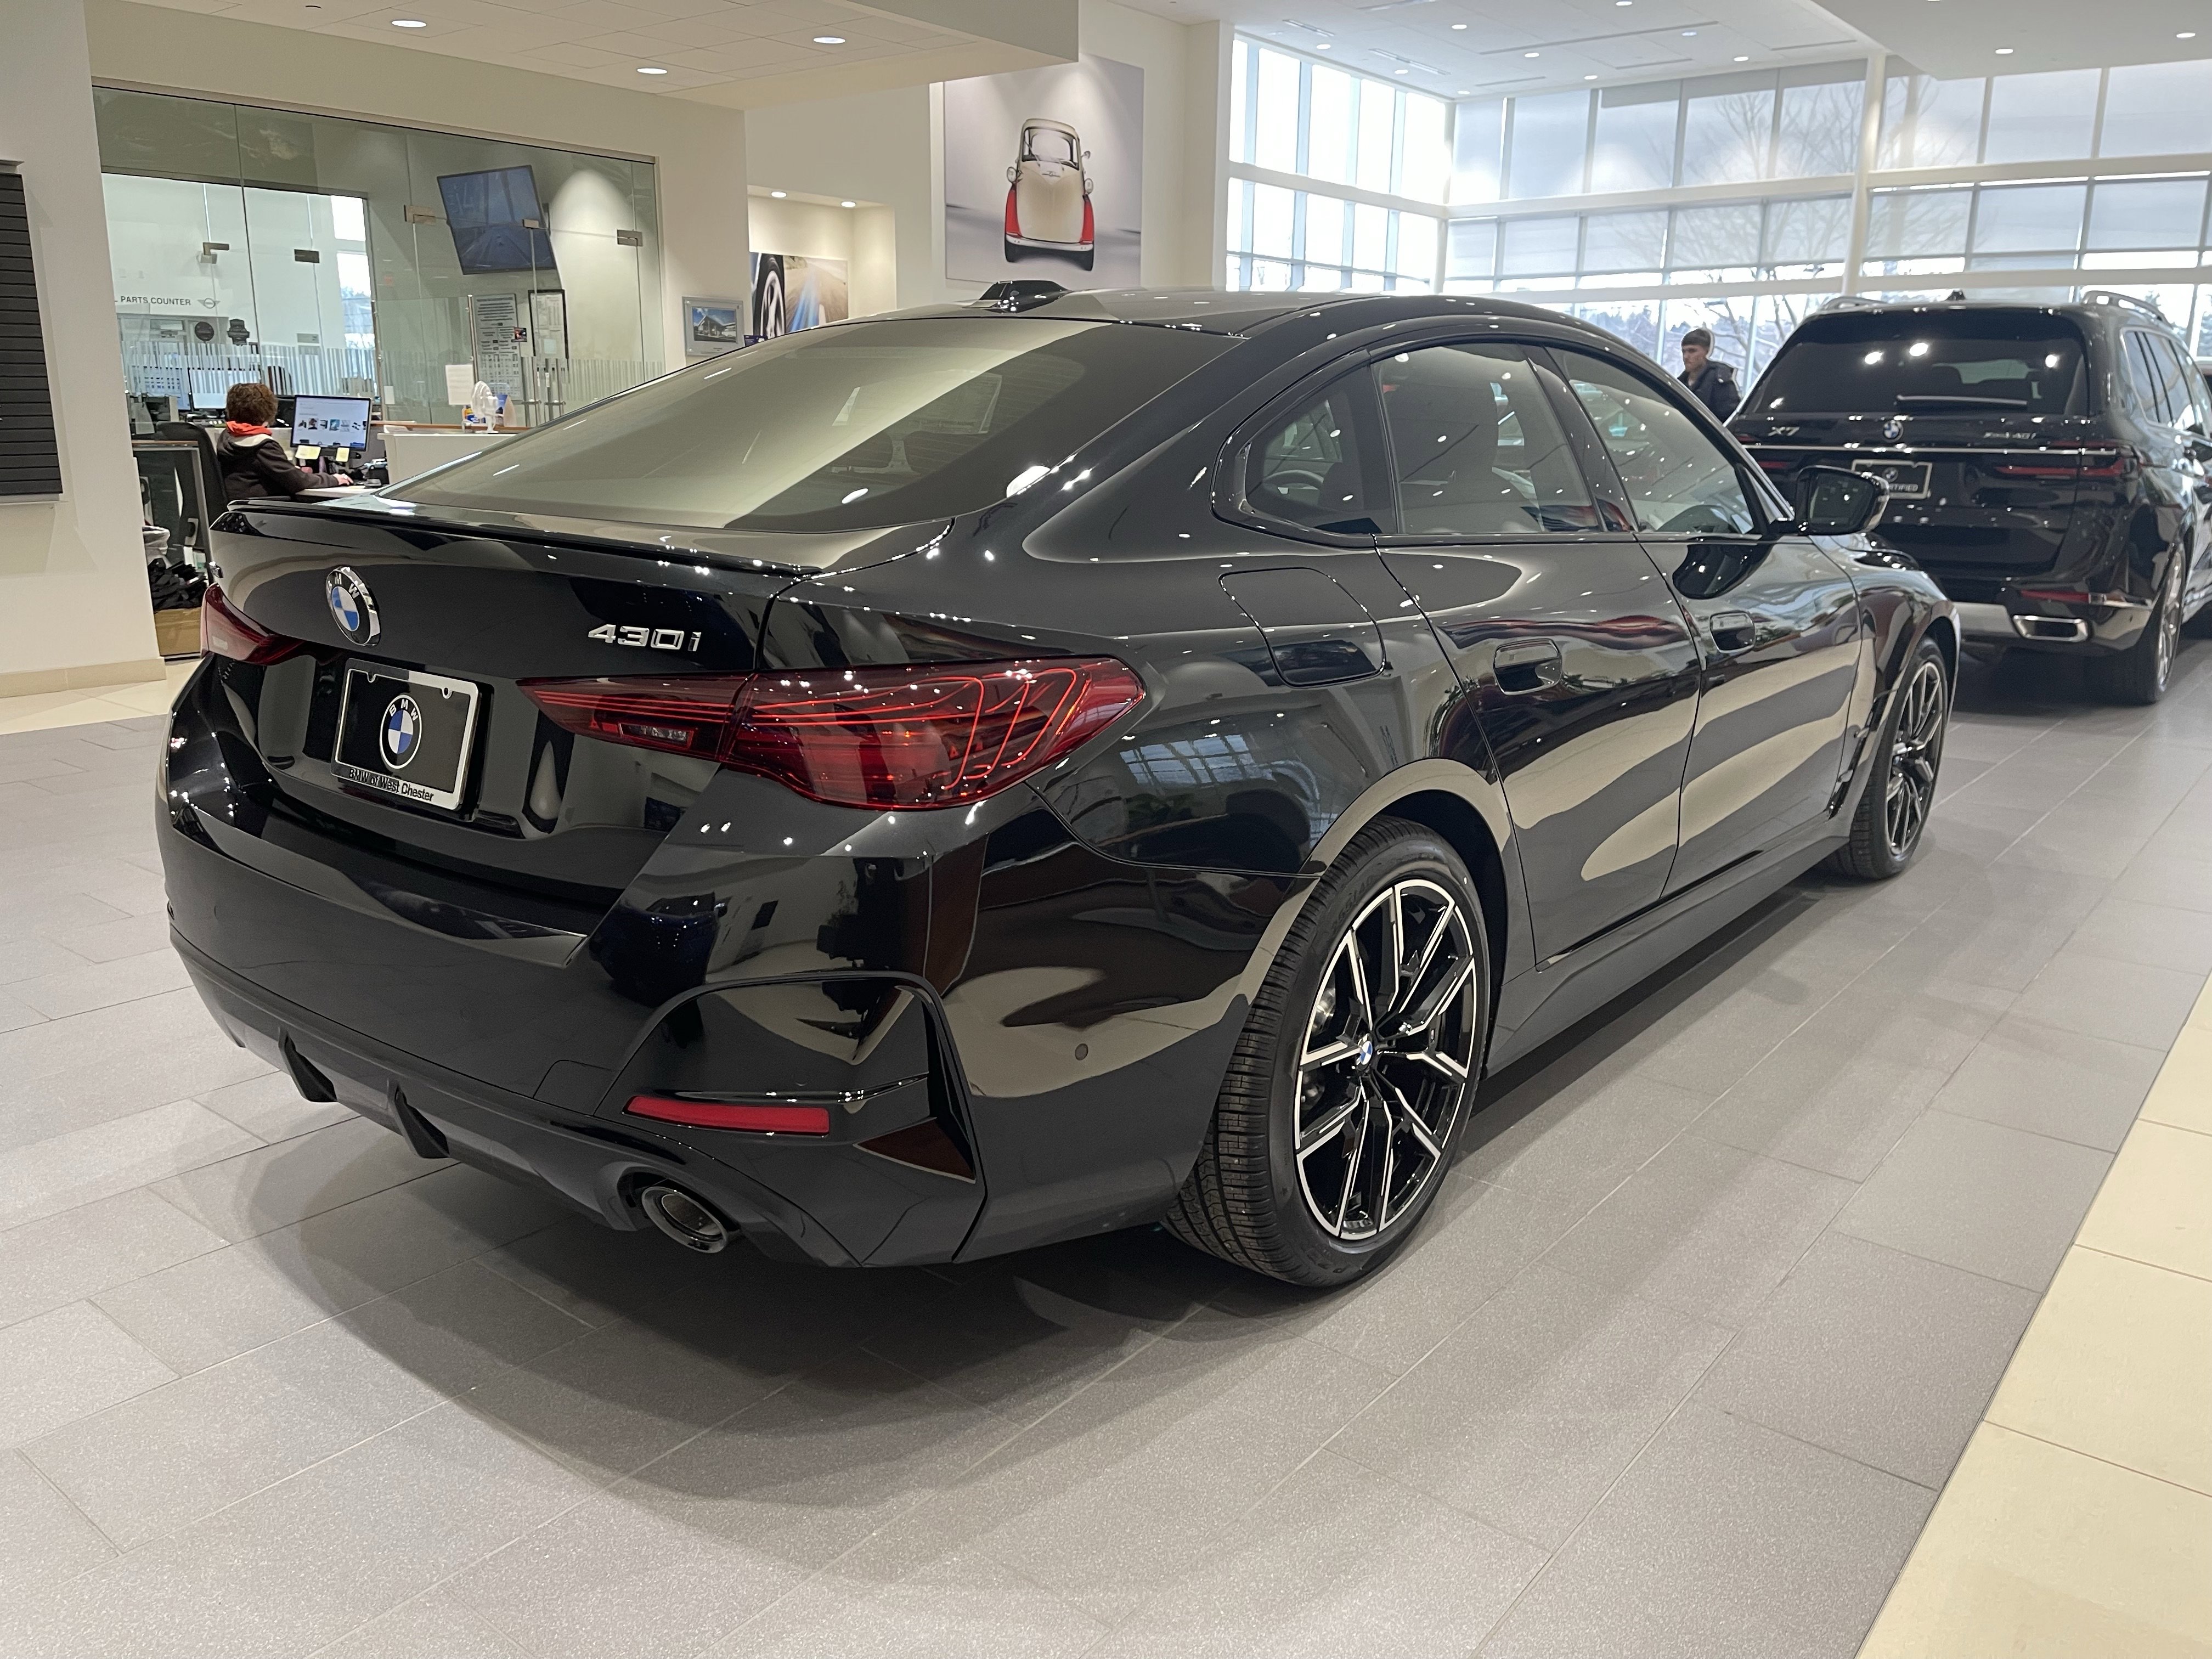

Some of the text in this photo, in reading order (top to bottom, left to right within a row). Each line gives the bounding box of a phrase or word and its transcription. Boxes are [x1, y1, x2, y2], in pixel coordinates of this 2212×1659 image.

[120, 296, 191, 306] PARTS COUNTER
[1768, 426, 1800, 437] X7
[327, 572, 360, 599] BMW
[588, 624, 702, 652] 430i
[389, 698, 419, 721] BMW
[349, 768, 435, 802] BMW of West Chester
